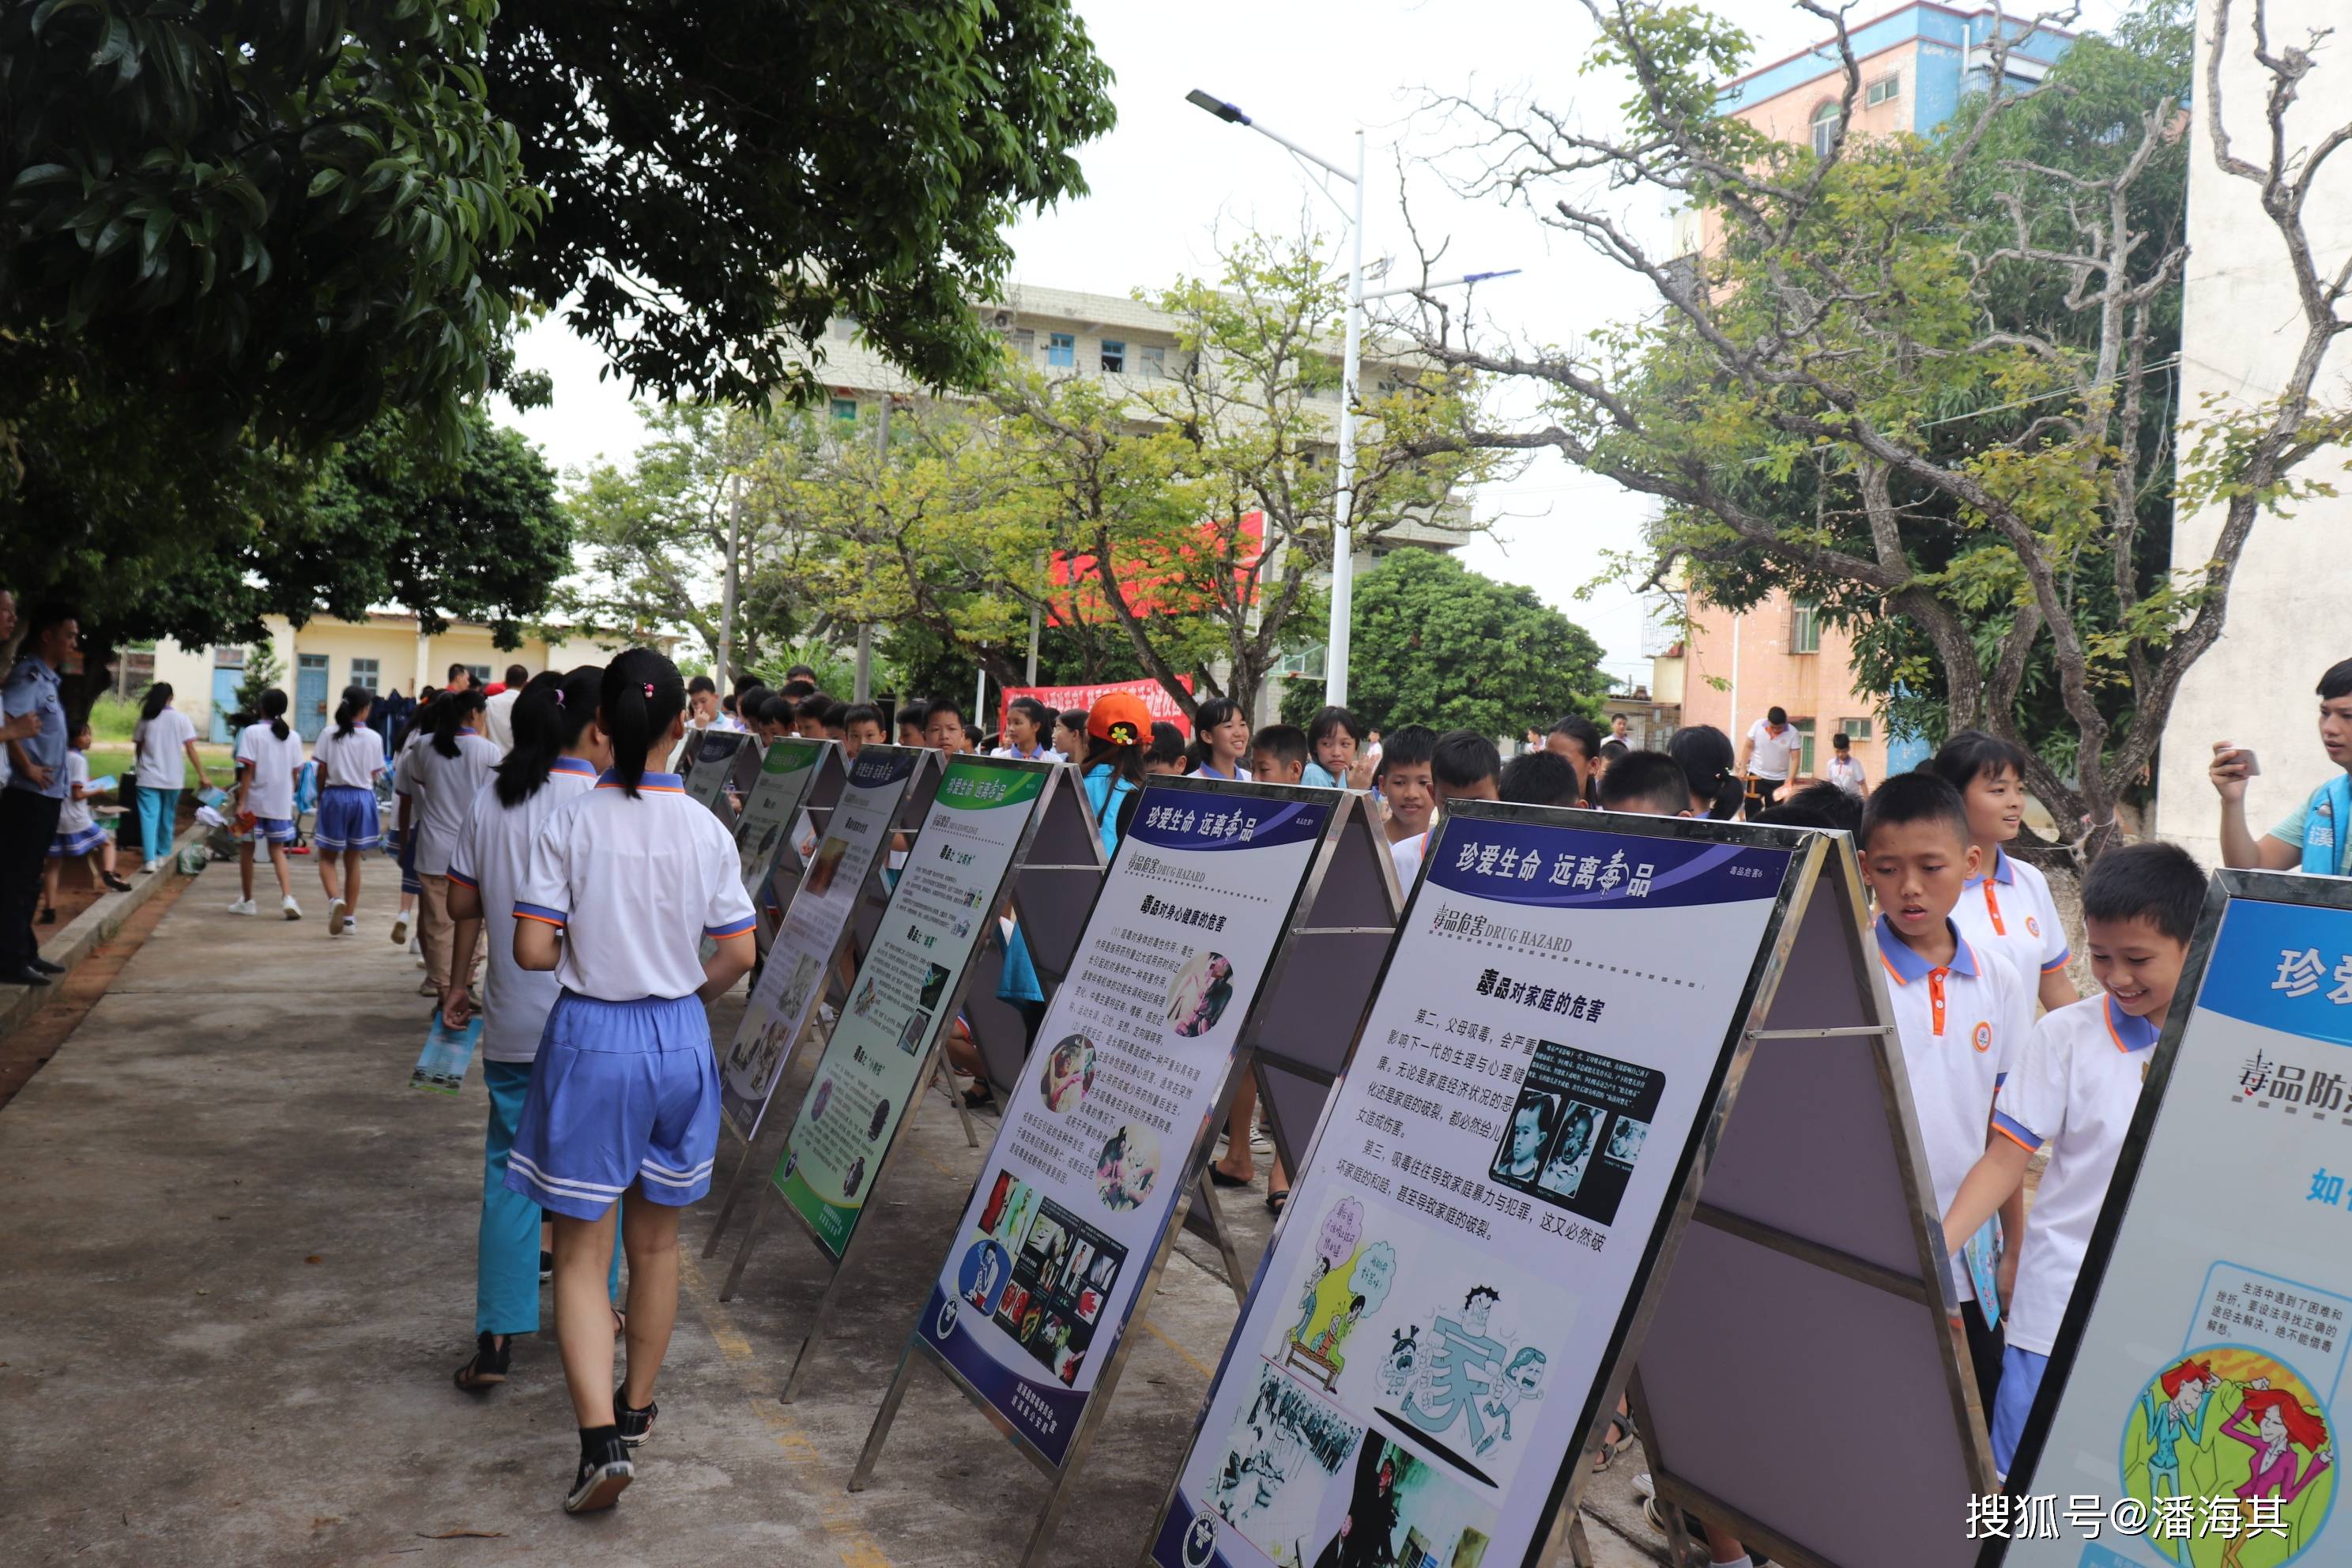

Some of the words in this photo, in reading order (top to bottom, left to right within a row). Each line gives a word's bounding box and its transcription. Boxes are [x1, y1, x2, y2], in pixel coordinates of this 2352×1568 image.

[948, 777, 974, 797] 珍爱生命
[974, 778, 1007, 801] 远离毒品
[1145, 805, 1196, 834] 珍爱生命
[1197, 807, 1257, 843] 远离毒品
[1128, 849, 1160, 874] 毒品危害
[1157, 864, 1177, 878] DRUG
[1175, 867, 1206, 883] HAZARD
[1456, 841, 1542, 882] 珍爱生命
[1549, 848, 1655, 899] 远离毒品
[1730, 865, 1762, 877] 毒品危害6
[1140, 894, 1227, 933] 毒品对身心健康的危害
[1433, 899, 1487, 937] 毒品危害
[1484, 923, 1518, 943] DRUG
[1518, 931, 1573, 953] HAZARD
[1476, 967, 1605, 1023] 毒品对家庭的危害
[1387, 1029, 1525, 1085] 影响下一代的生理与心理健
[1376, 1055, 1514, 1113] 康。无论是家庭经济状况的恶
[2238, 1048, 2352, 1113] 毒品防
[1355, 1107, 1405, 1138] 女造成伤害。
[2305, 1167, 2352, 1212] 如
[2242, 1282, 2343, 1321] 生活中遇到了困难和
